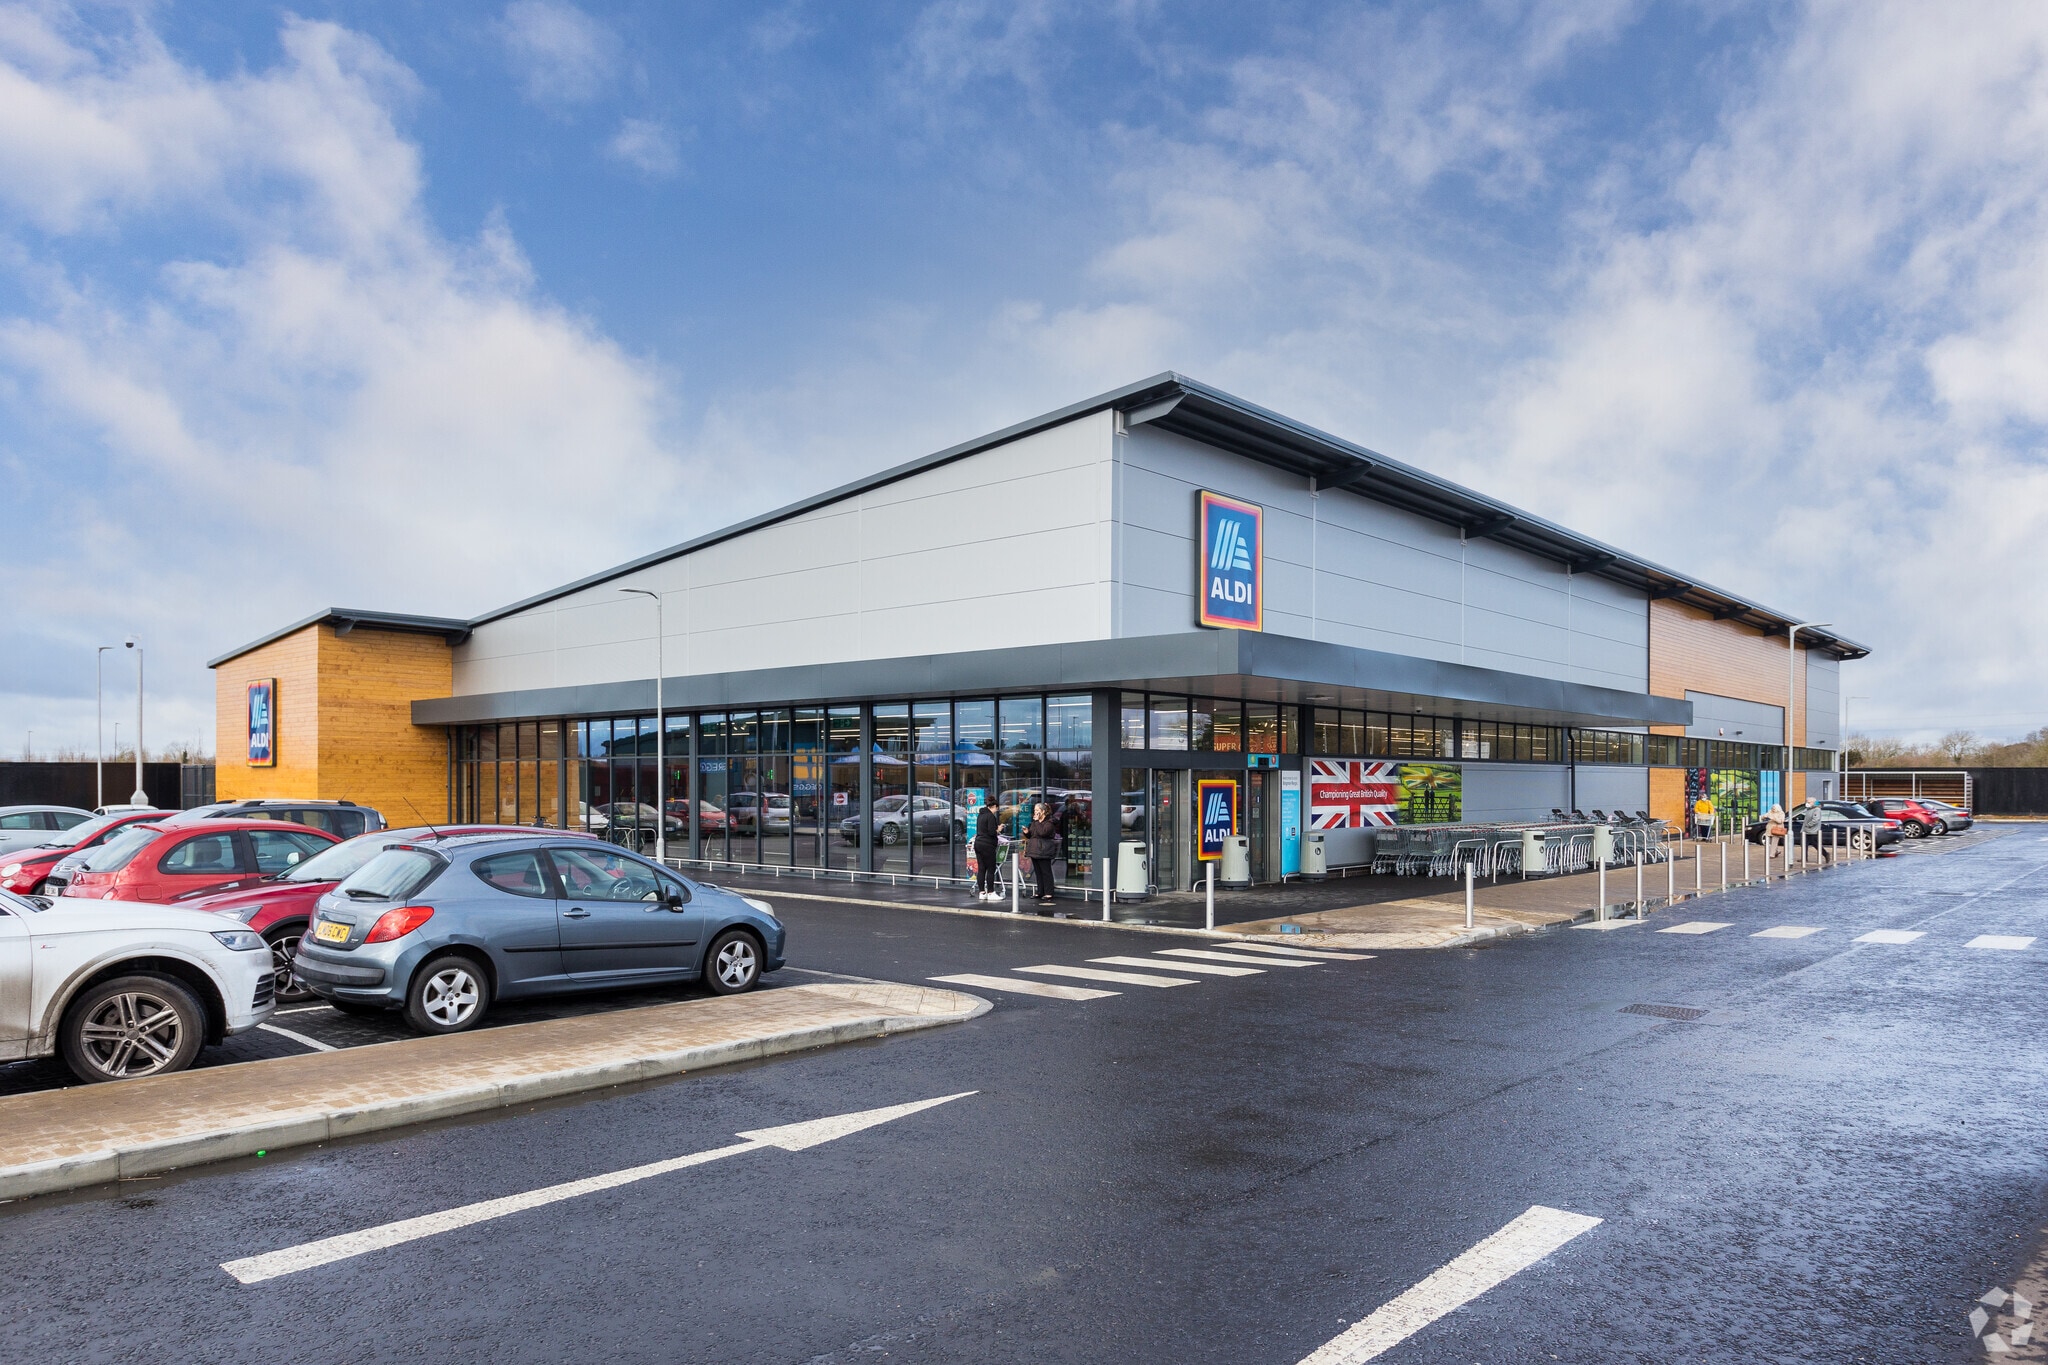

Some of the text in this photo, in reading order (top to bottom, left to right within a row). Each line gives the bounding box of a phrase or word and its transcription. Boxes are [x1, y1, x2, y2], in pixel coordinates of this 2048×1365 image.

[1211, 577, 1252, 605] ALDI
[251, 732, 268, 748] ALDI
[1320, 789, 1388, 800] Championing Great British Quality
